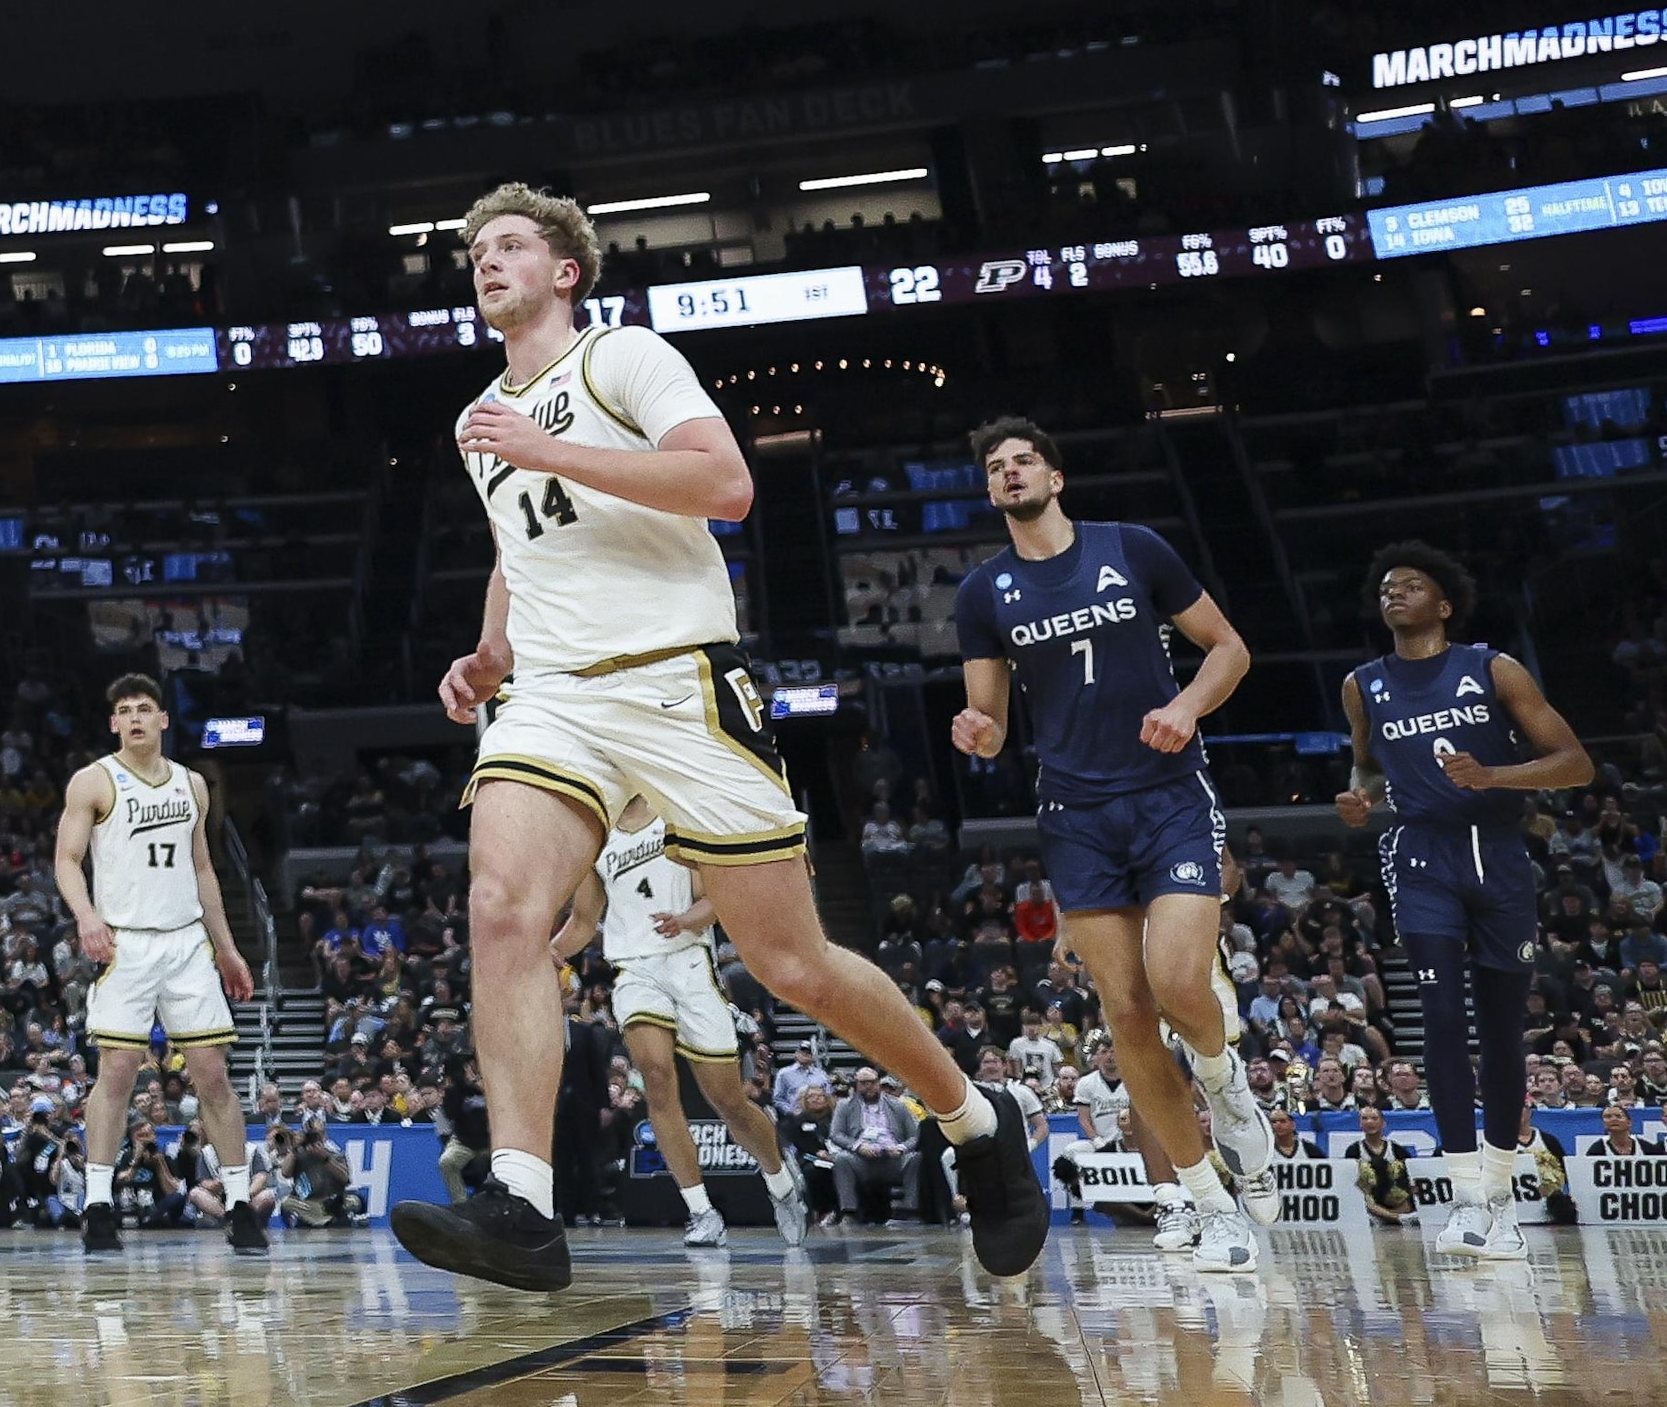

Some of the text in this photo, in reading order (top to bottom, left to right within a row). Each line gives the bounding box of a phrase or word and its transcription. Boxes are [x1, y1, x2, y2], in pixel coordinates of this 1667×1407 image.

[1373, 7, 1667, 90] MARCHMADNES
[1252, 243, 1289, 269] 40
[1325, 234, 1347, 261] 0
[676, 287, 751, 318] 9:51
[889, 265, 942, 305] 22
[234, 342, 252, 366] 0
[350, 332, 384, 357] 50
[457, 322, 475, 347] 3
[518, 476, 579, 541] 14
[1010, 597, 1137, 647] QUEENS
[1070, 637, 1095, 686] 7
[1381, 704, 1491, 742] QUEENS
[126, 796, 192, 832] Purdue
[147, 842, 178, 869] 17
[636, 876, 654, 899] 4
[1276, 1163, 1333, 1190] HOO
[1279, 1195, 1340, 1222] HOO
